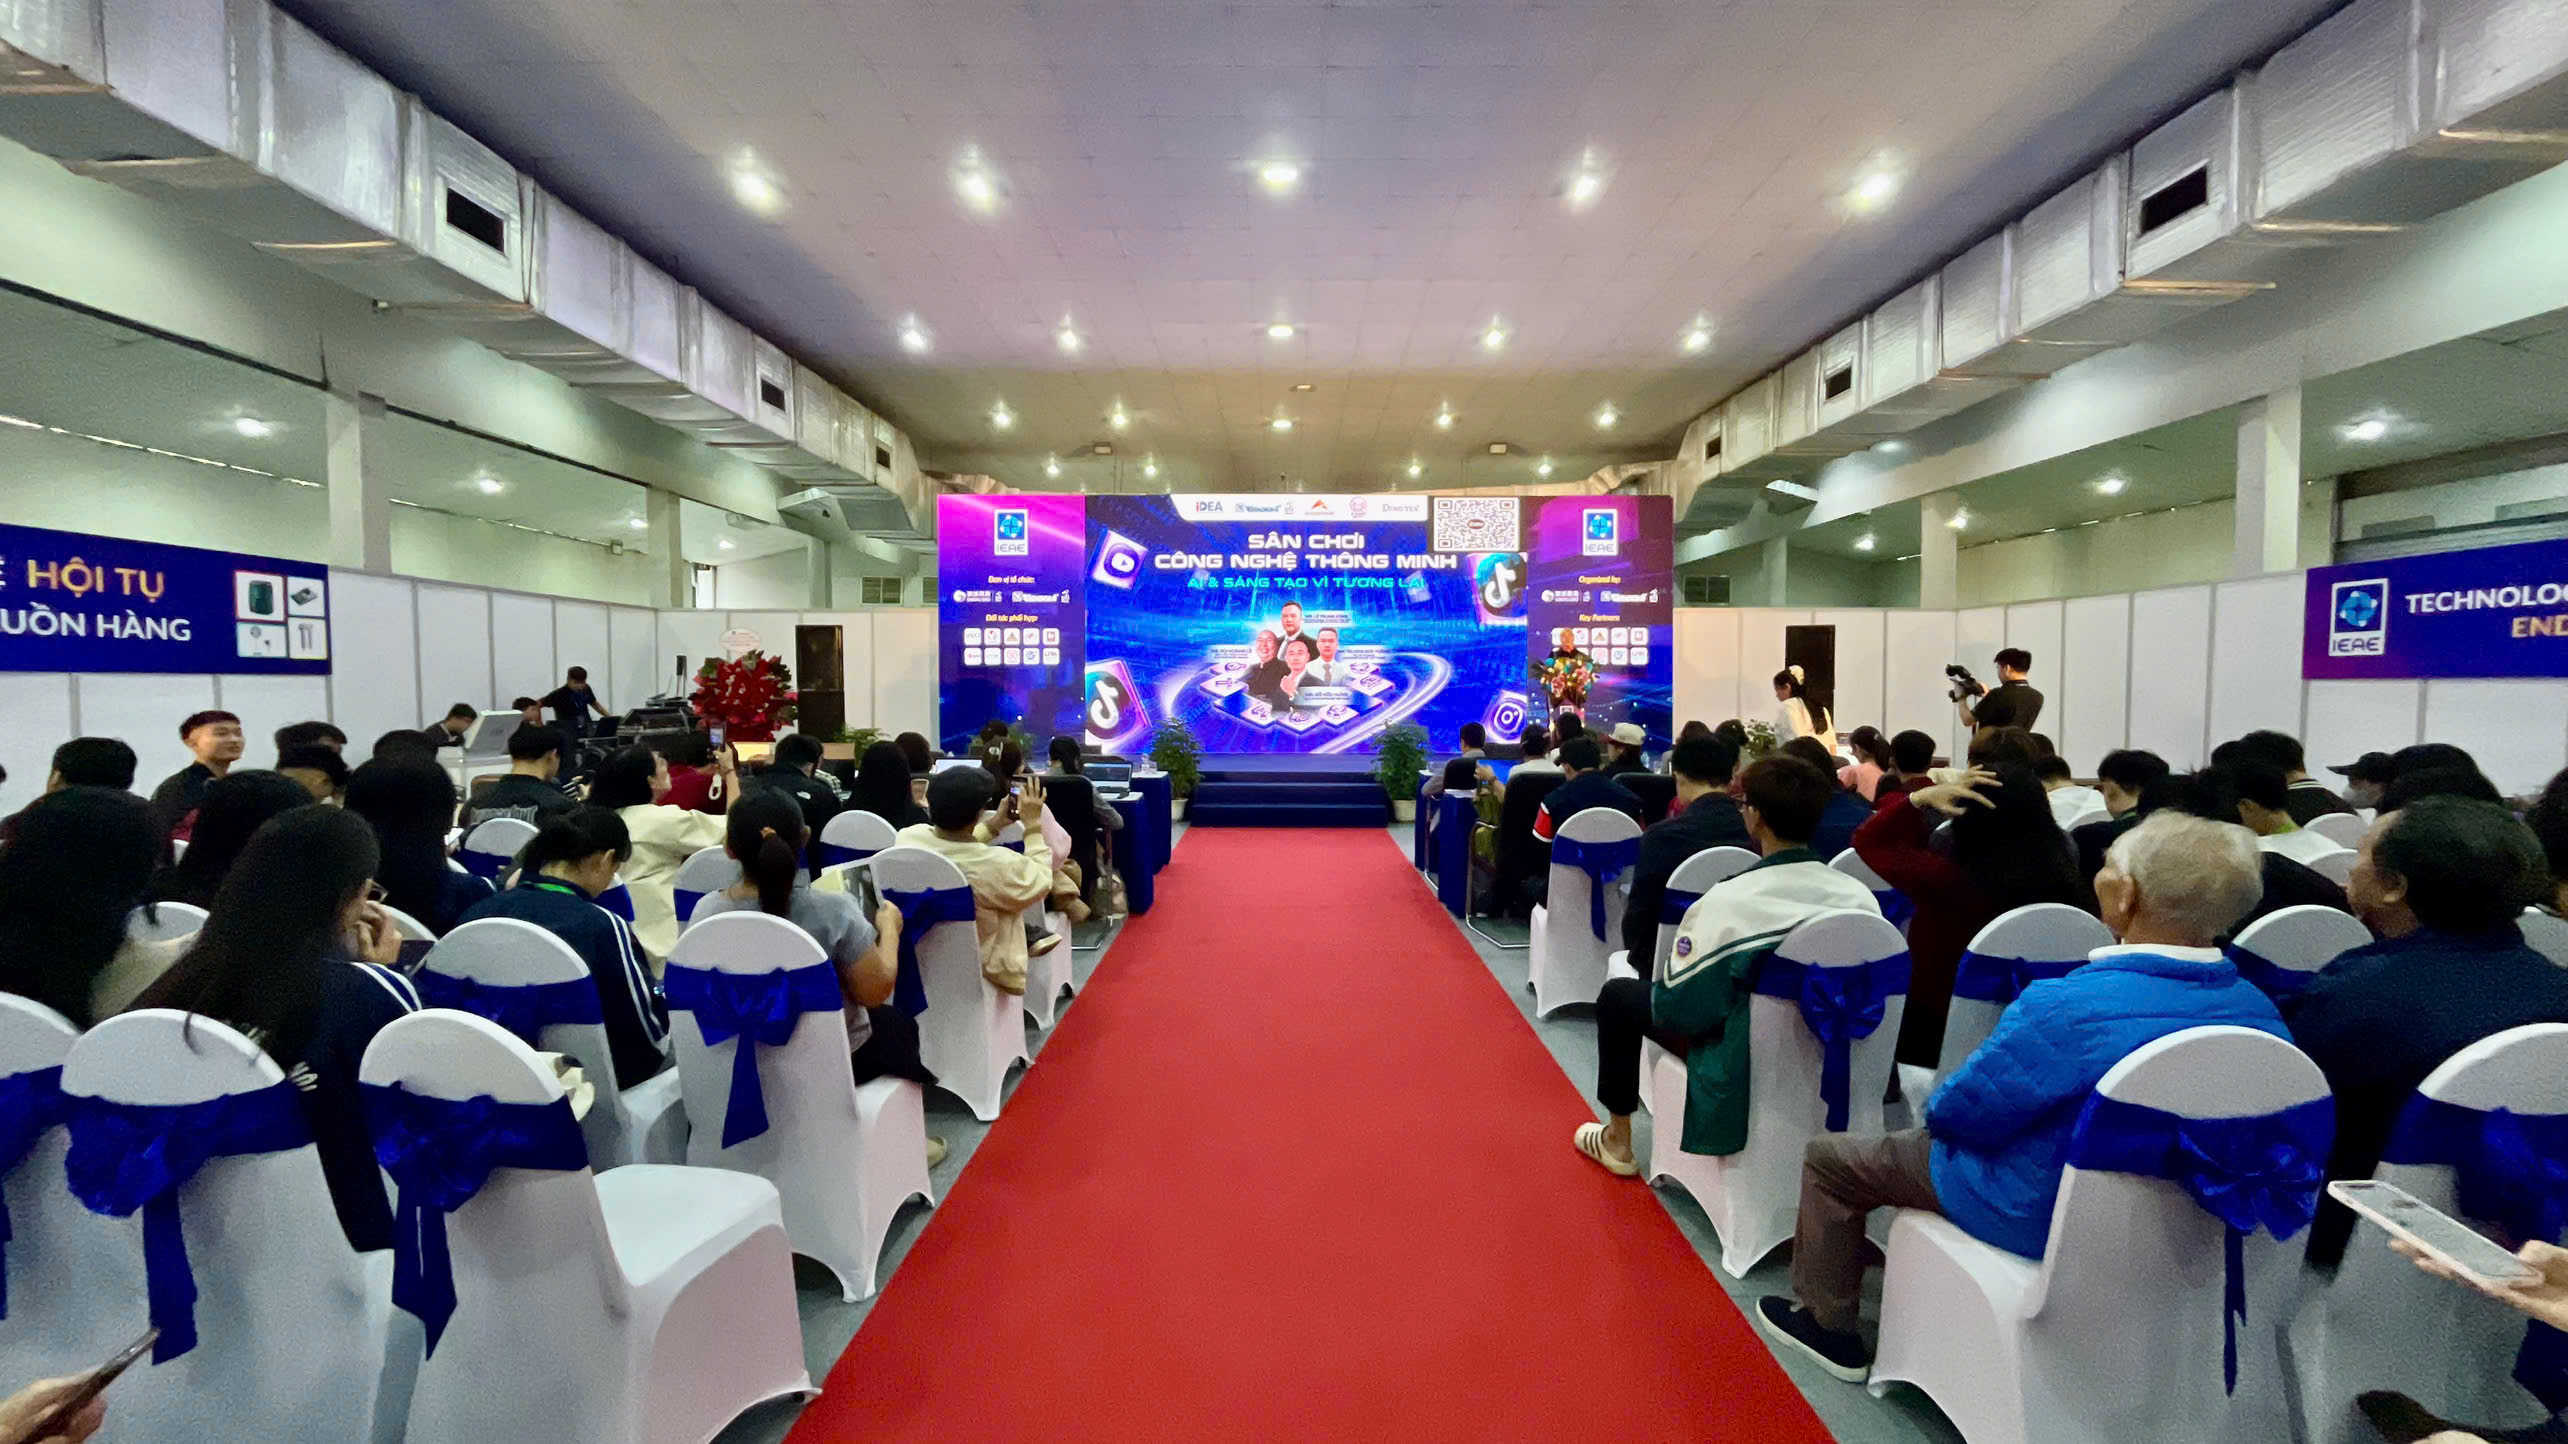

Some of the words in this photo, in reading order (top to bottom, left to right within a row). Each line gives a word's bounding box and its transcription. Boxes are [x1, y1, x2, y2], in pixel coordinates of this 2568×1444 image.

[1196, 501, 1223, 512] iDEA
[996, 543, 1026, 553] IEAE
[1248, 531, 1301, 550] SÂN
[1309, 532, 1365, 550] CHƠI
[1585, 543, 1615, 553] IEAE
[1154, 551, 1223, 570] CÔNG
[1230, 551, 1297, 573] NGHỆ
[1305, 551, 1390, 570] THÔNG
[1396, 554, 1458, 570] MINH
[27, 556, 104, 598] HỘI
[114, 567, 164, 603] TỤ
[1187, 578, 1205, 589] AI
[1208, 578, 1219, 589] &
[1224, 576, 1270, 589] SÁNG
[1274, 578, 1308, 591] TẠO
[1312, 575, 1328, 589] VÌ
[1333, 577, 1394, 589] TƯƠNG
[1398, 578, 1426, 589] LAI
[2405, 583, 2568, 614] TECHNOLO
[96, 609, 191, 642] HÀNG
[2332, 637, 2381, 653] IEAE
